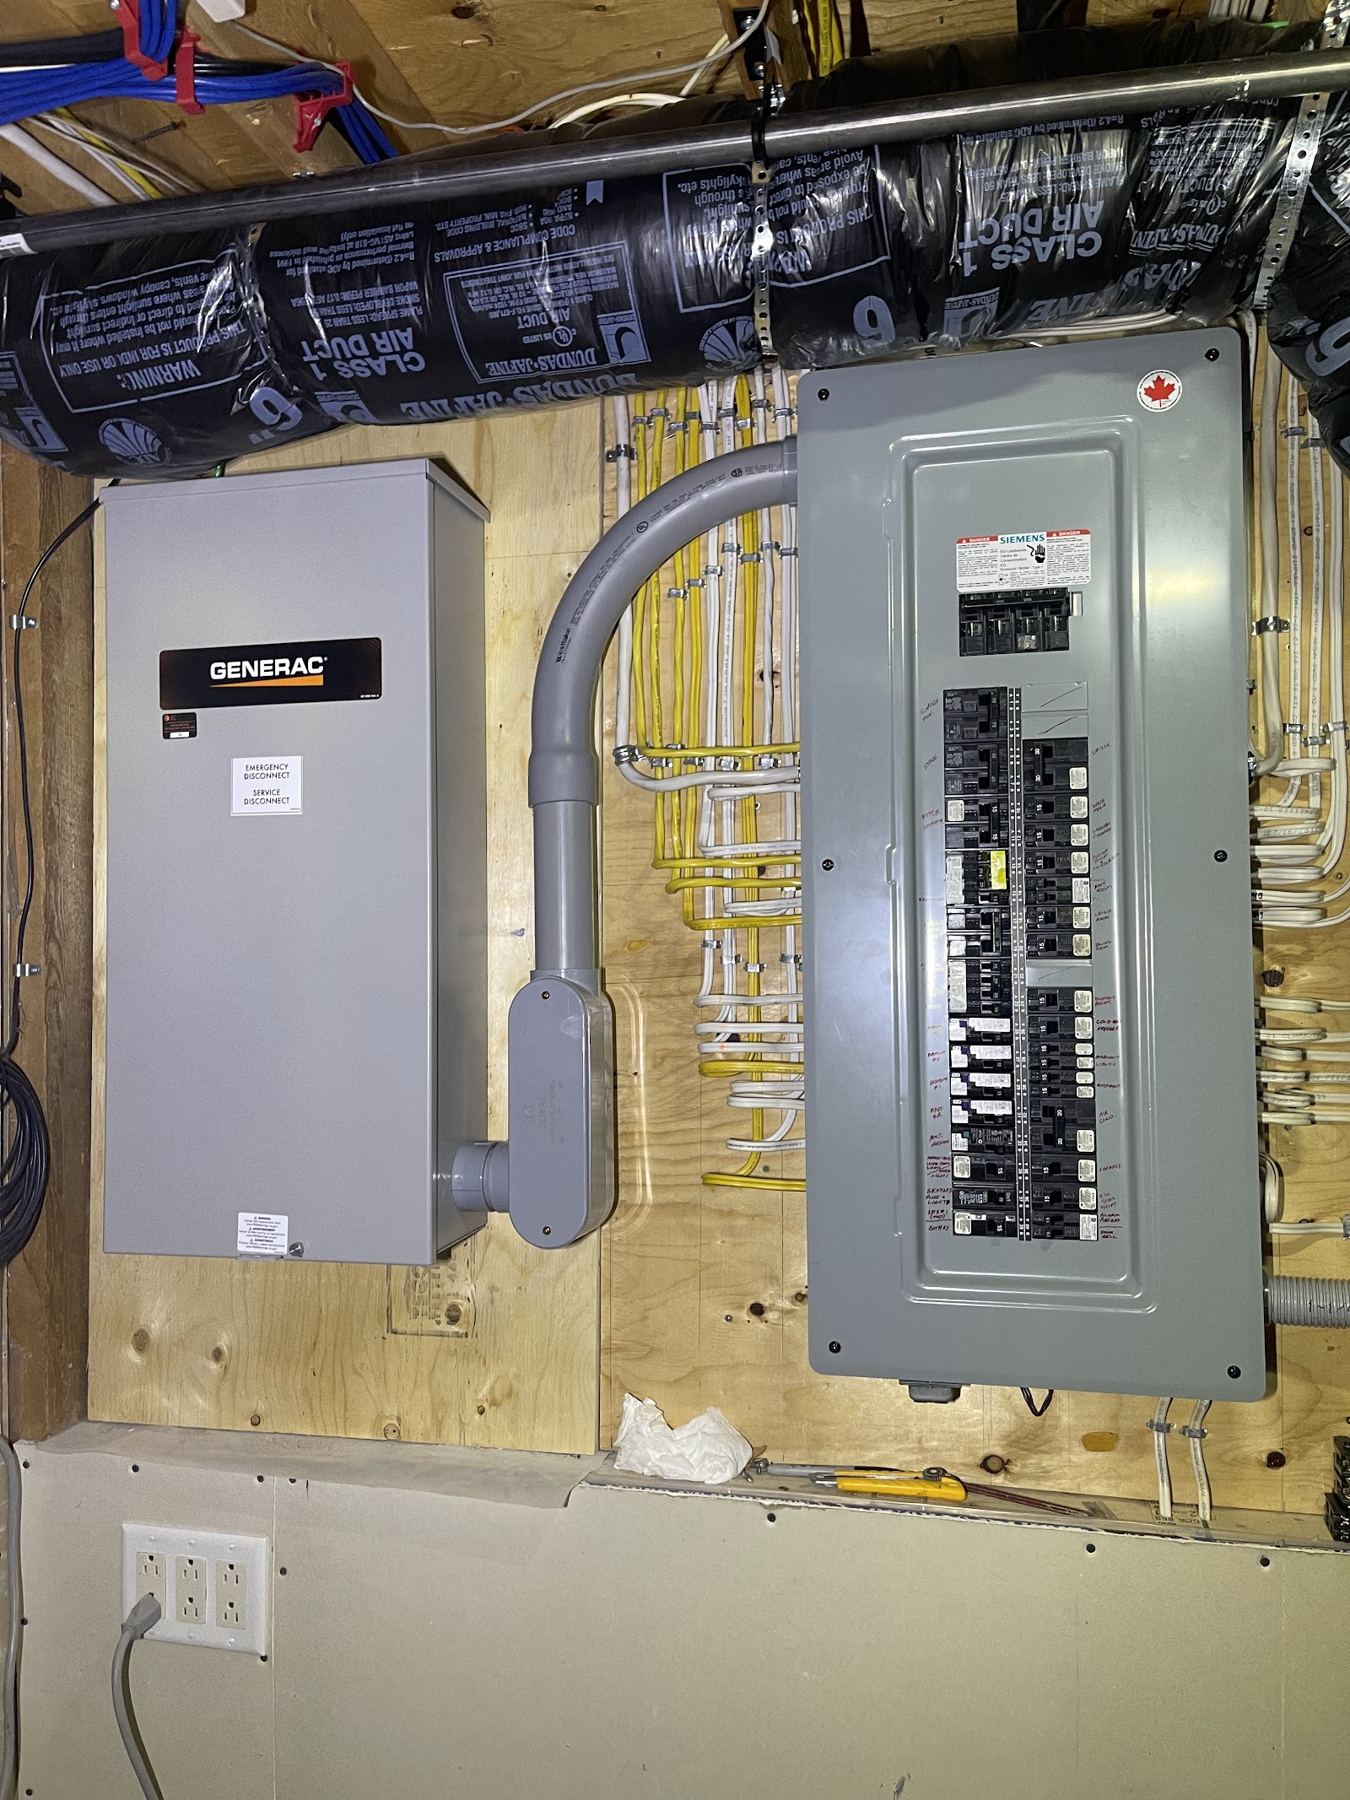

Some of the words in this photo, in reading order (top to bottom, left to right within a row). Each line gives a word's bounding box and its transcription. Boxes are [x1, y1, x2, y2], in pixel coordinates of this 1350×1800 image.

[1014, 125, 1032, 136] ADC
[833, 149, 865, 169] Avoid
[794, 183, 804, 195] to
[694, 189, 735, 206] through
[846, 206, 872, 225] THIS
[1052, 200, 1103, 231] AIR
[550, 224, 575, 237] CODE
[956, 208, 1041, 248] DUCT
[493, 229, 548, 250] COMPLIANCE
[776, 230, 788, 244] IS
[434, 244, 482, 262] APPROVALS
[484, 242, 491, 252] &
[990, 231, 1101, 268] CLASS
[962, 251, 977, 276] 1
[140, 279, 170, 294] canopy
[171, 274, 199, 286] vents,
[100, 288, 138, 304] windows
[153, 291, 181, 304] where
[90, 306, 116, 320] enters
[147, 306, 172, 321] direct
[175, 303, 185, 314] to
[101, 315, 135, 331] indirect
[136, 312, 146, 322] or
[517, 311, 548, 328] DUCT
[143, 323, 156, 334] be
[156, 320, 171, 333] not
[79, 335, 105, 348] where
[106, 326, 143, 344] installed
[370, 327, 412, 352] AIR
[522, 334, 542, 343] LISTED
[55, 342, 71, 353] may
[71, 340, 79, 351] it
[139, 344, 160, 360] FOR
[160, 342, 172, 355] IS
[301, 334, 368, 361] DUCT
[59, 362, 81, 377] ONLY
[80, 358, 101, 373] USE
[310, 363, 326, 380] 1
[333, 351, 424, 377] CLASS
[1000, 534, 1045, 544] SIEMENS
[210, 657, 324, 680] GENERAC
[245, 763, 288, 771] EMERGENCY
[244, 771, 289, 779] DISCONNECT
[253, 788, 280, 796] SERVICE
[244, 796, 289, 805] DISCONNECT
